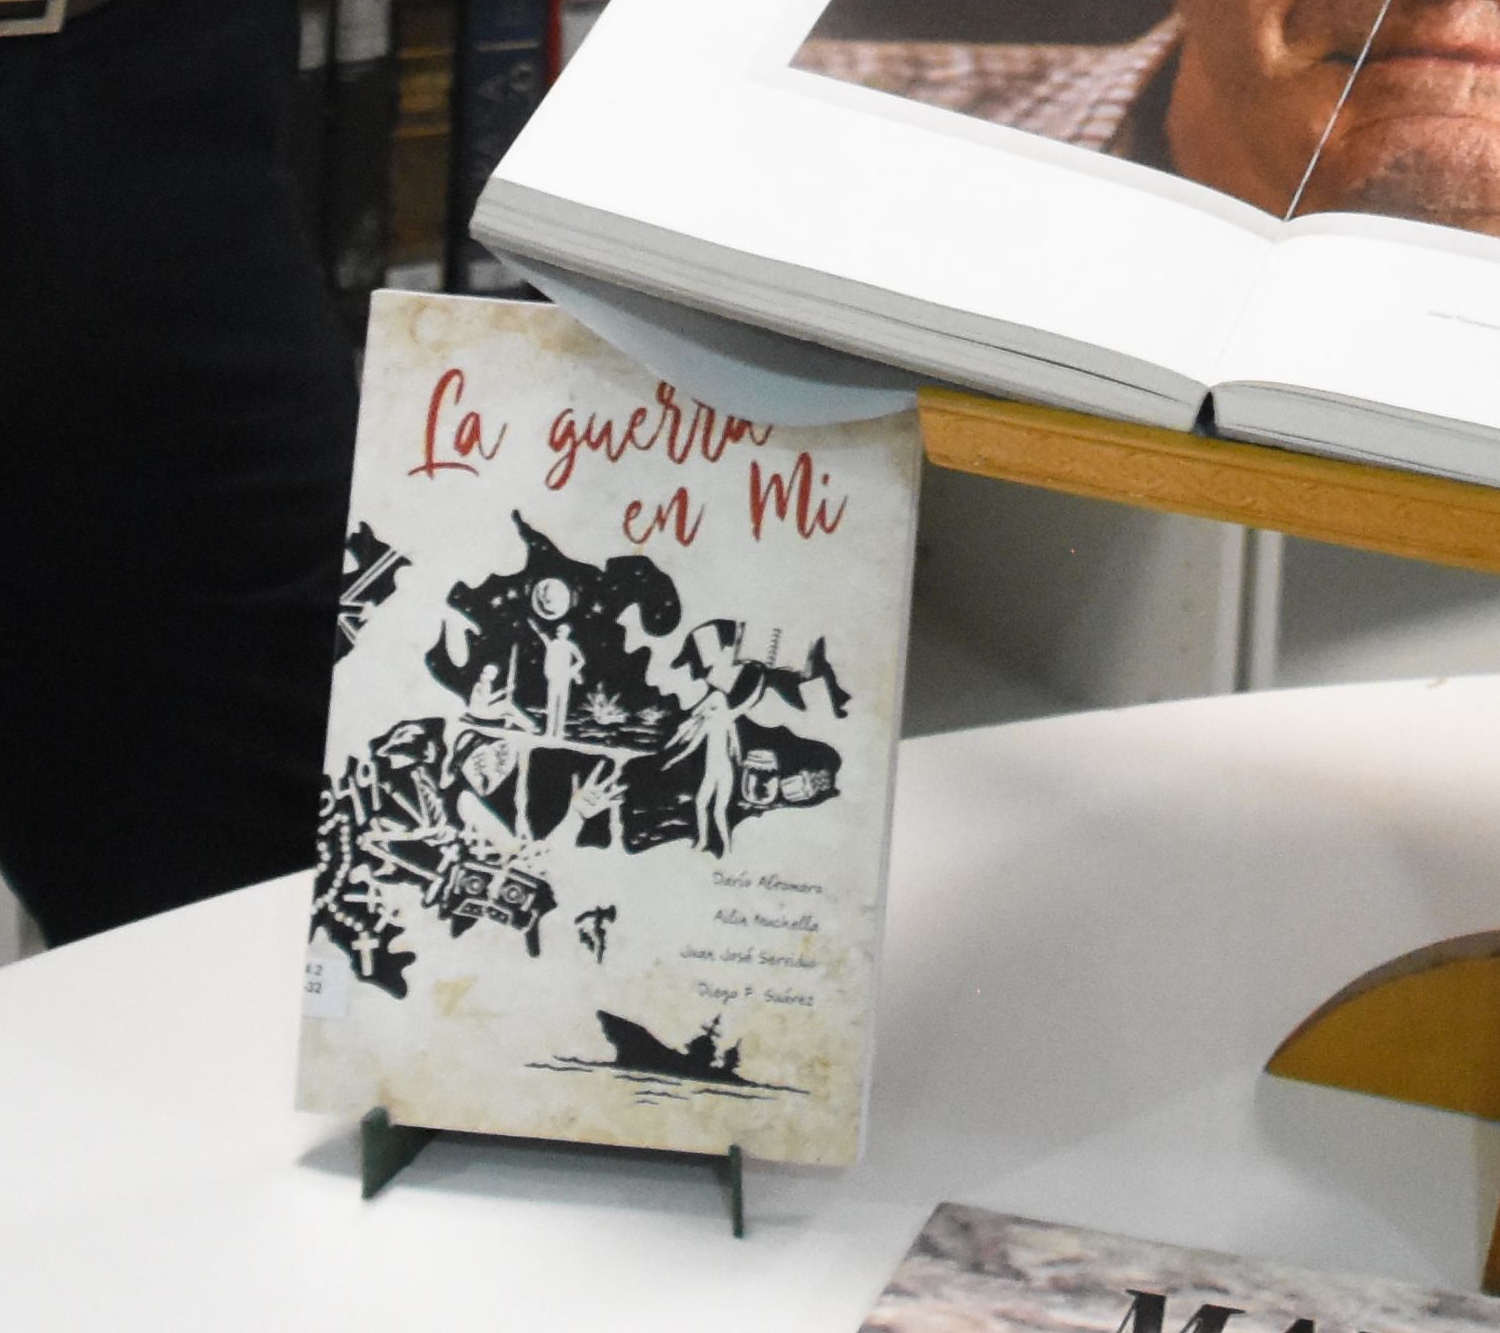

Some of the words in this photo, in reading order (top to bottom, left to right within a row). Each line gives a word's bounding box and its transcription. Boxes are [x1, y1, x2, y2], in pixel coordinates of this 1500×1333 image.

[407, 368, 507, 480] La
[544, 379, 773, 491] guerra
[622, 486, 705, 547] en
[749, 451, 848, 542] Mi
